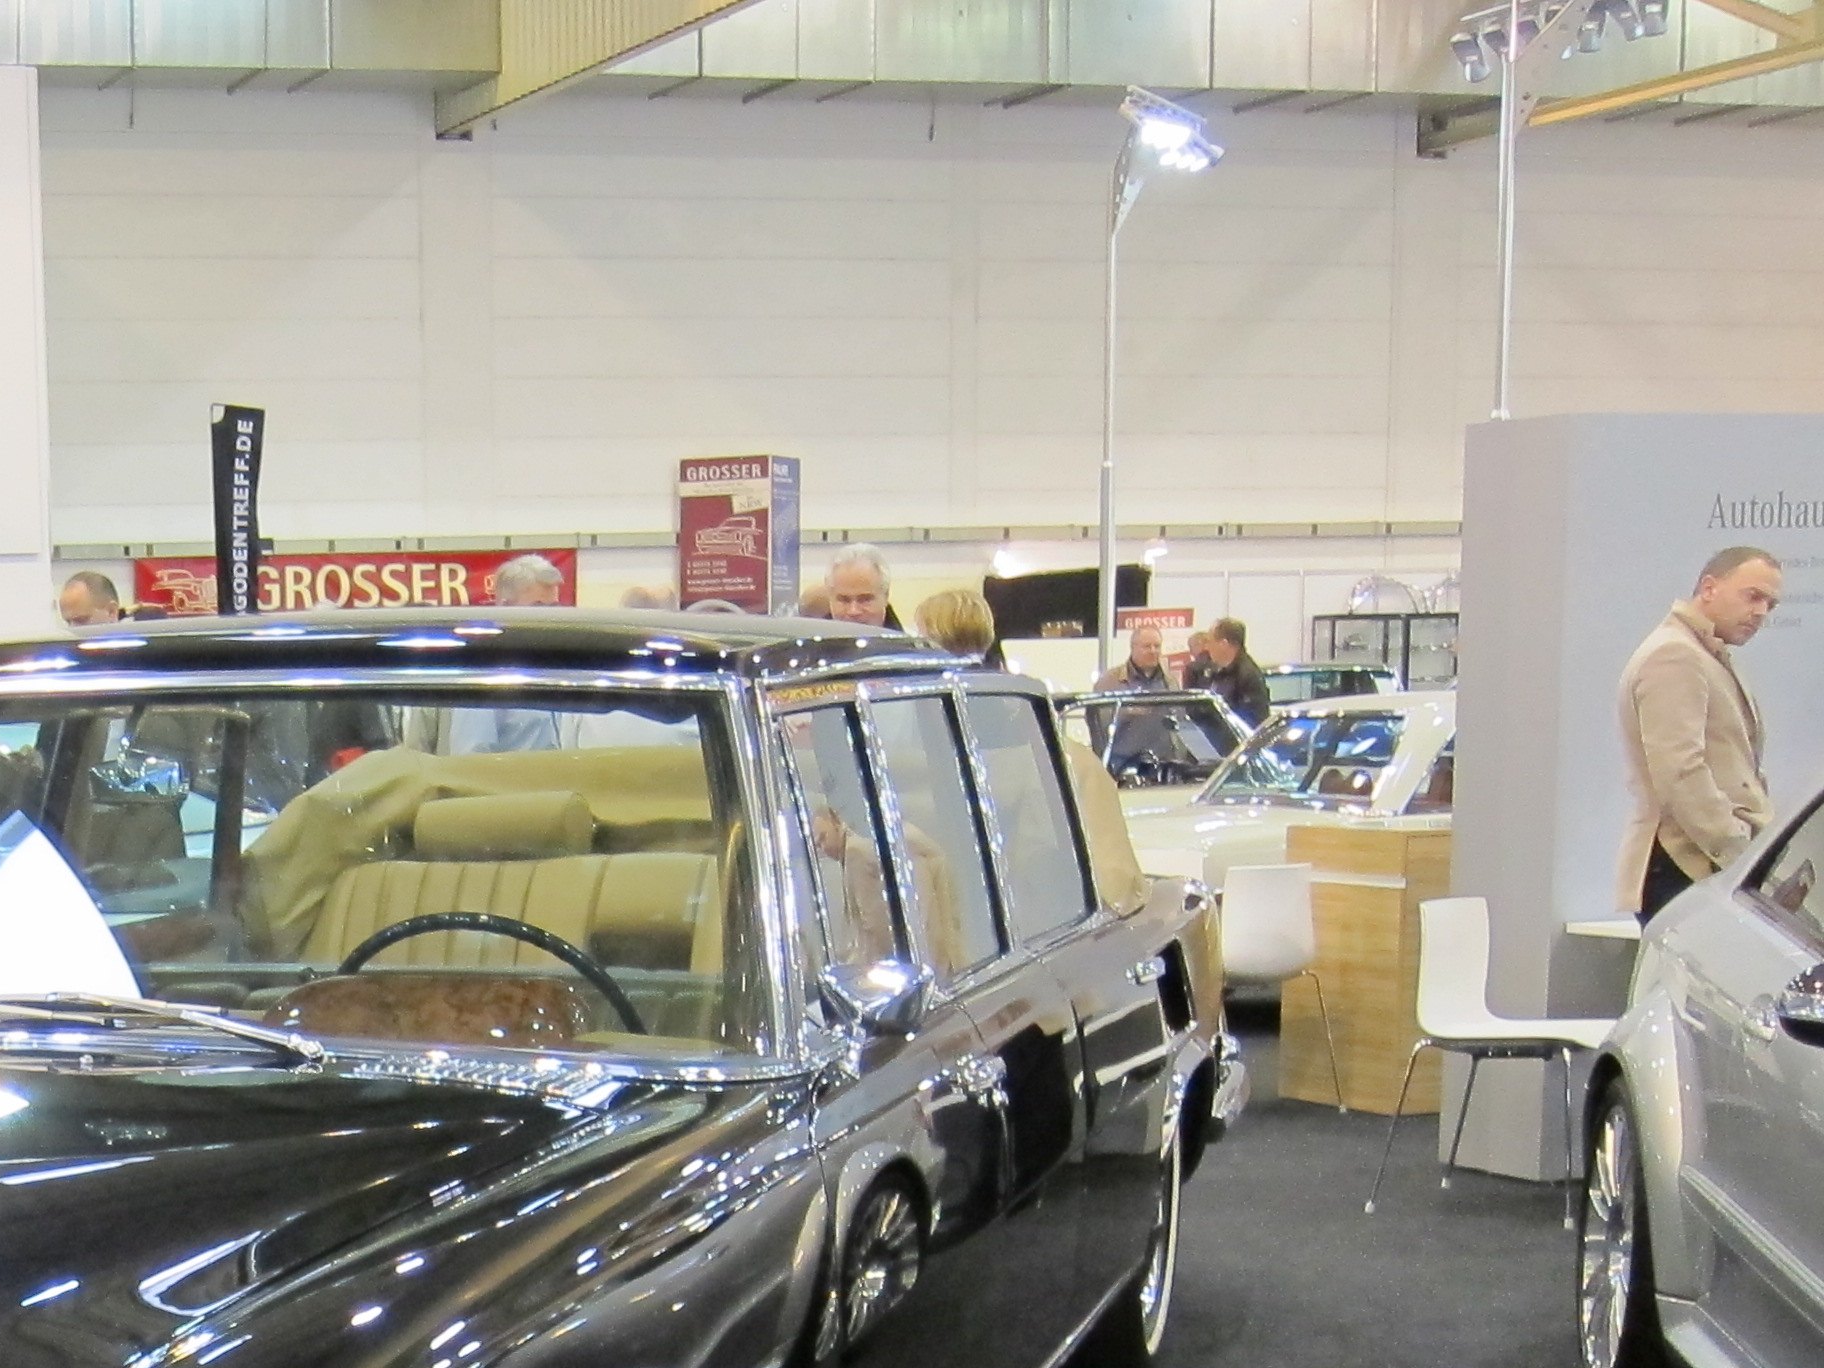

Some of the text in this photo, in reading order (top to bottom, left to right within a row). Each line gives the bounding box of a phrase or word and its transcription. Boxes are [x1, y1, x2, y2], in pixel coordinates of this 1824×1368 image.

[686, 464, 761, 480] GROSSER
[233, 419, 254, 615] GODENTREFF.DE
[256, 563, 470, 610] GROSSER
[1124, 616, 1186, 628] GROSSER
